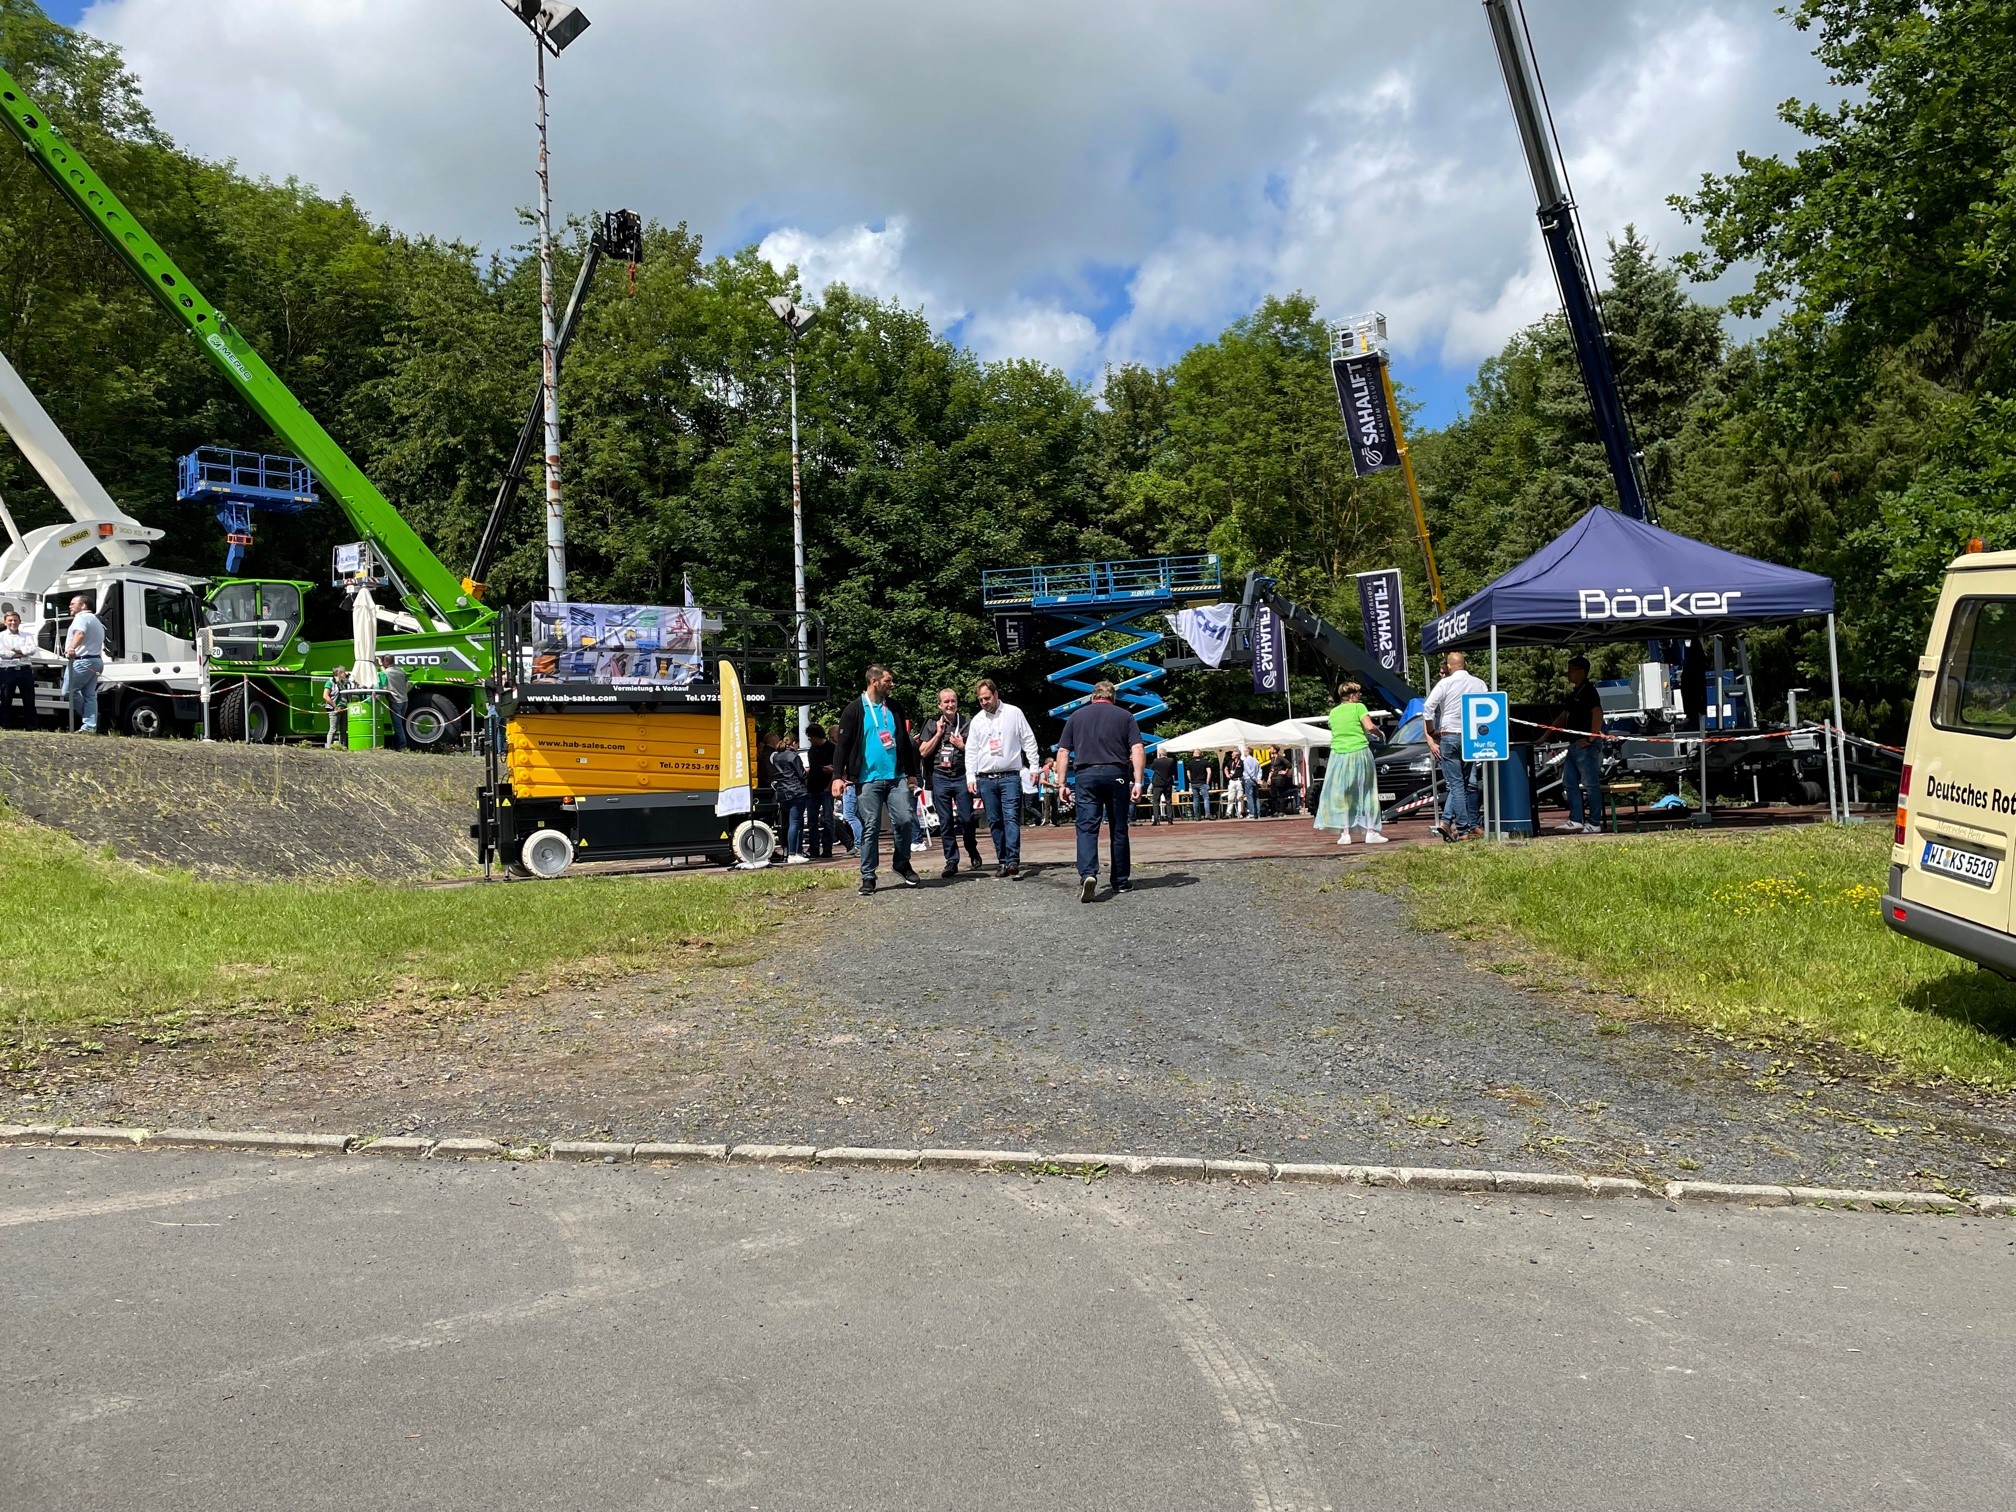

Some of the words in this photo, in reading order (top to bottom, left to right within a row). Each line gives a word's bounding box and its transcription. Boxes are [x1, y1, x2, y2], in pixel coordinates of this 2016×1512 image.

[222, 347, 252, 380] MERLO
[1364, 361, 1379, 405] SOLUTIONS
[1346, 362, 1379, 446] SAHALIFT
[1375, 407, 1386, 442] PREMIUM
[60, 529, 89, 547] PALFINGER
[1578, 586, 1742, 620] Böcker
[1006, 618, 1019, 650] ALIFT
[1436, 610, 1471, 645] Böcker
[212, 648, 221, 656] 20
[394, 655, 441, 665] ROTO
[526, 694, 618, 702] www.hab-sales.com
[612, 685, 654, 693] Vermietung
[685, 694, 700, 702] Tel.
[1468, 697, 1500, 740] P
[538, 739, 626, 750] www.hab-sales.com
[1486, 740, 1497, 748] für
[659, 761, 674, 769] Tel.
[1926, 775, 1988, 809] Deutsches
[1991, 788, 2016, 815] Rot
[1965, 856, 1994, 879] 5518
